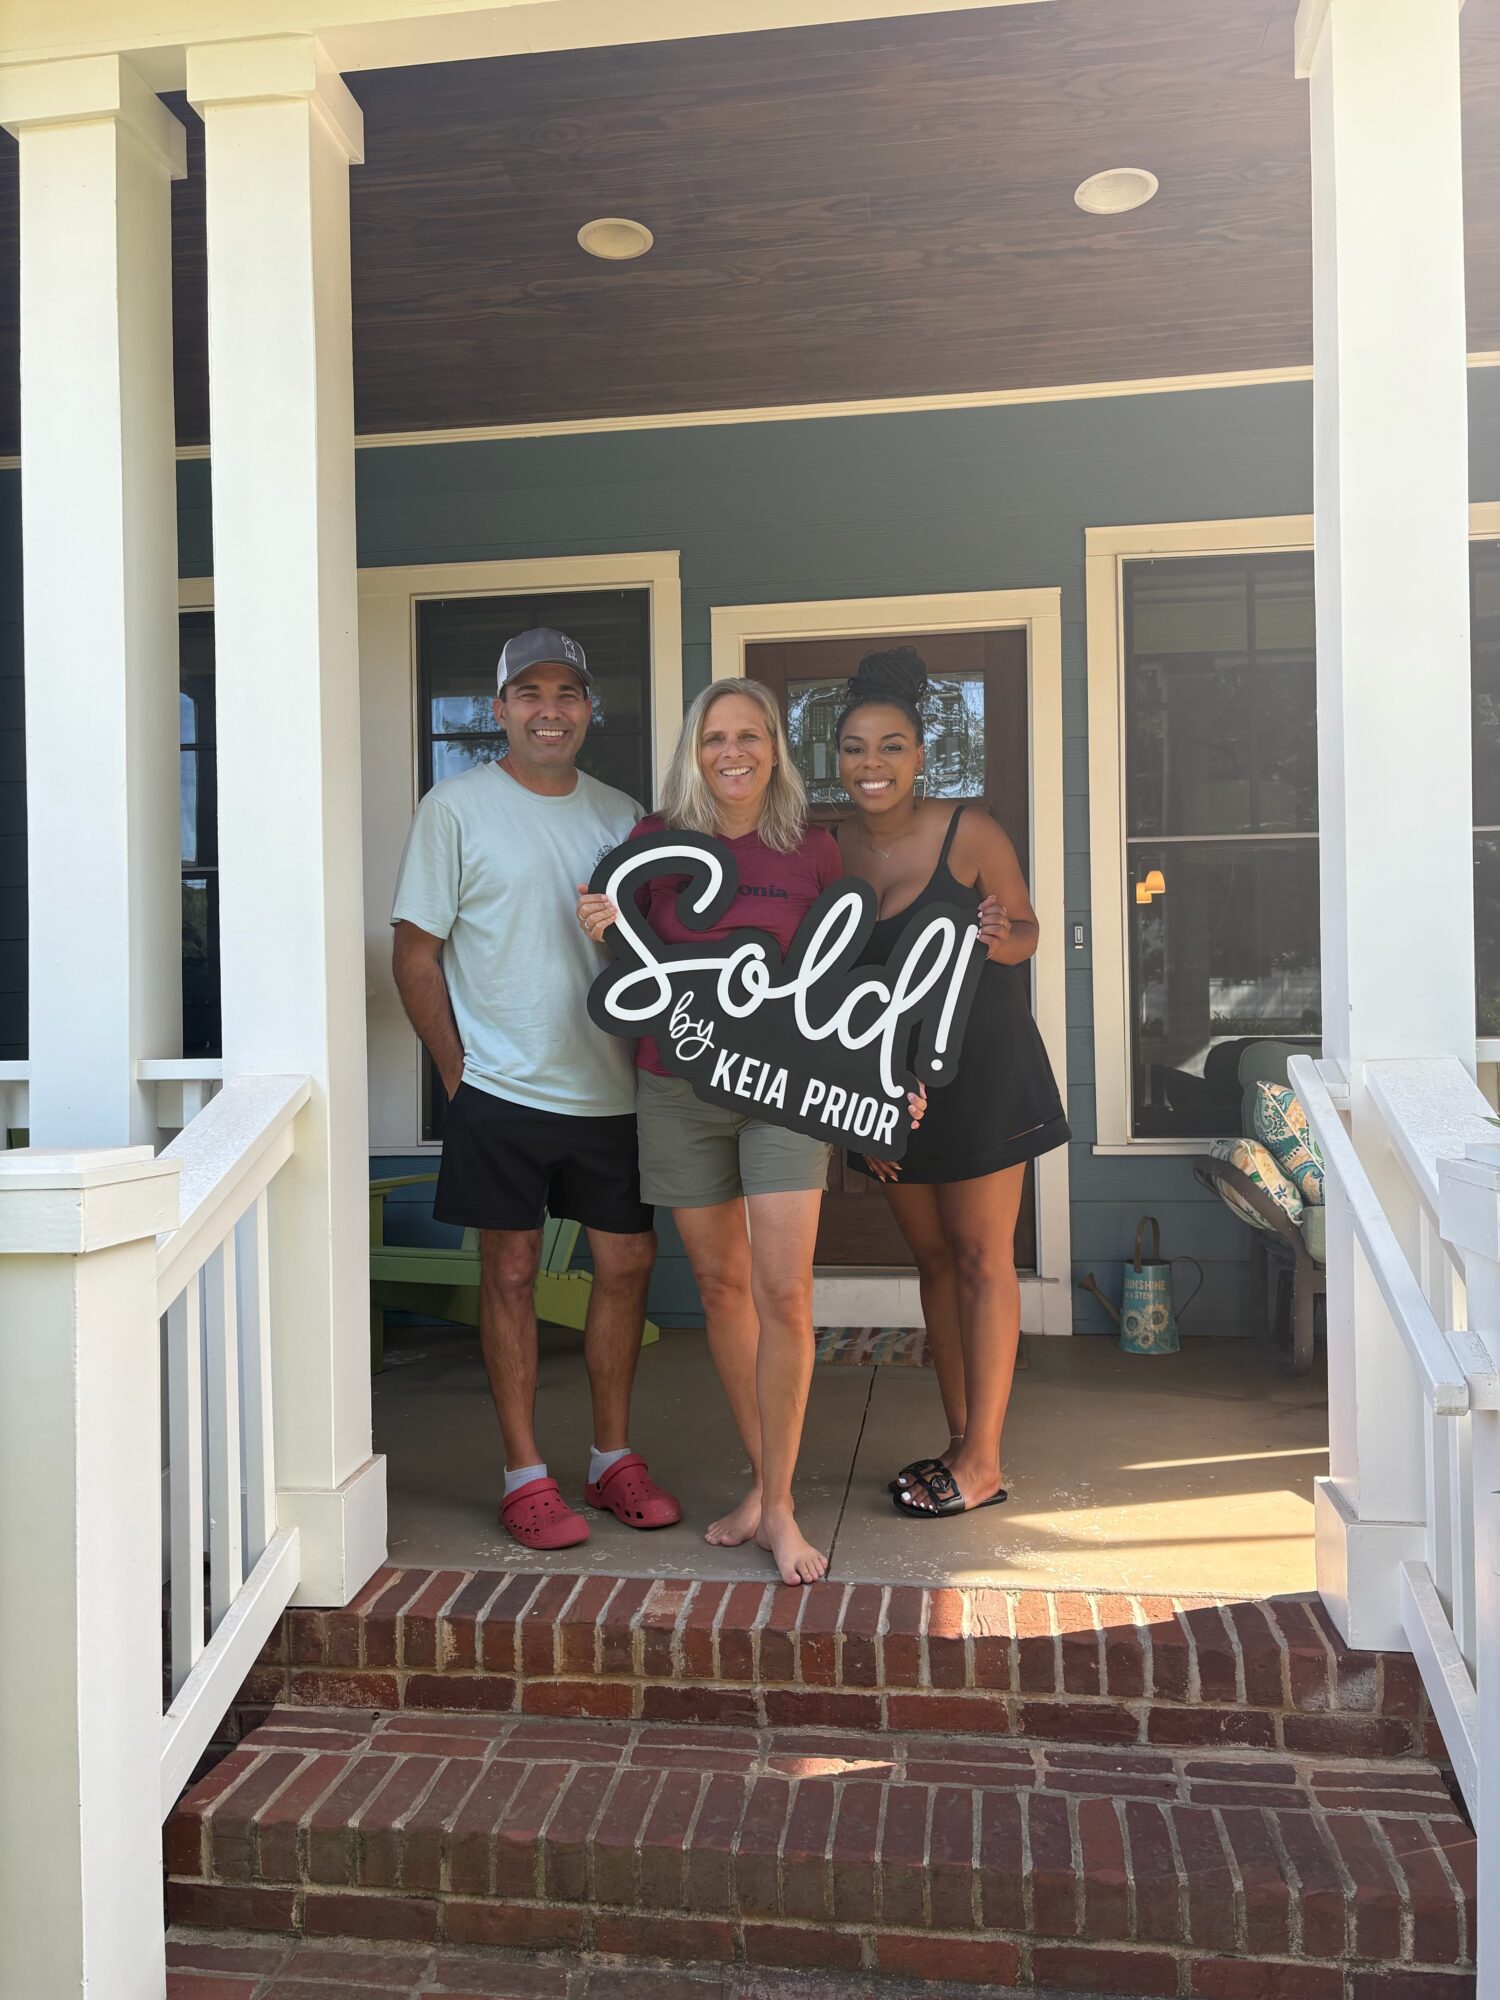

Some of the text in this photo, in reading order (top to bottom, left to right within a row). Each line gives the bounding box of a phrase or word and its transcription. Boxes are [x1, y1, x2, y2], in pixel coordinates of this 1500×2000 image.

[604, 845, 979, 1099] Sold!
[669, 990, 715, 1061] by
[710, 1048, 900, 1146] KEIA PRIOR
[1124, 1279, 1167, 1291] SUNSHINE
